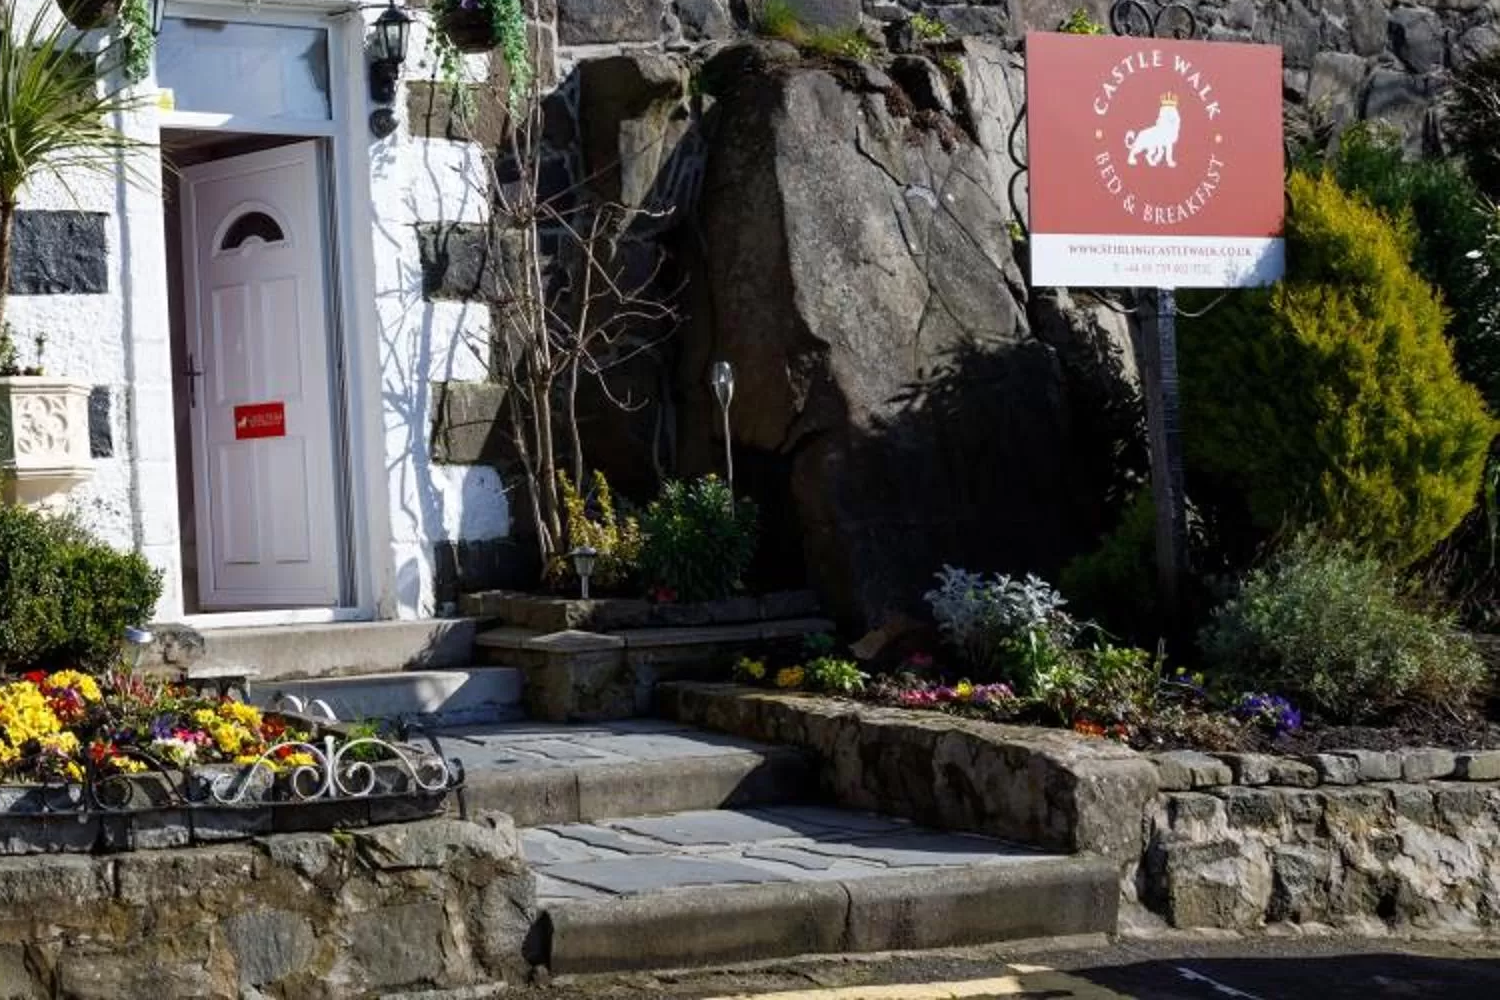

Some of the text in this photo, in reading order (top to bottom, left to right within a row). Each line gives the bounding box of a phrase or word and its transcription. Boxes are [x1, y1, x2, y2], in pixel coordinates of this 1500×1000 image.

[1093, 49, 1221, 121] CASTLE WALK
[1095, 151, 1225, 226] BED & BREAKFAST
